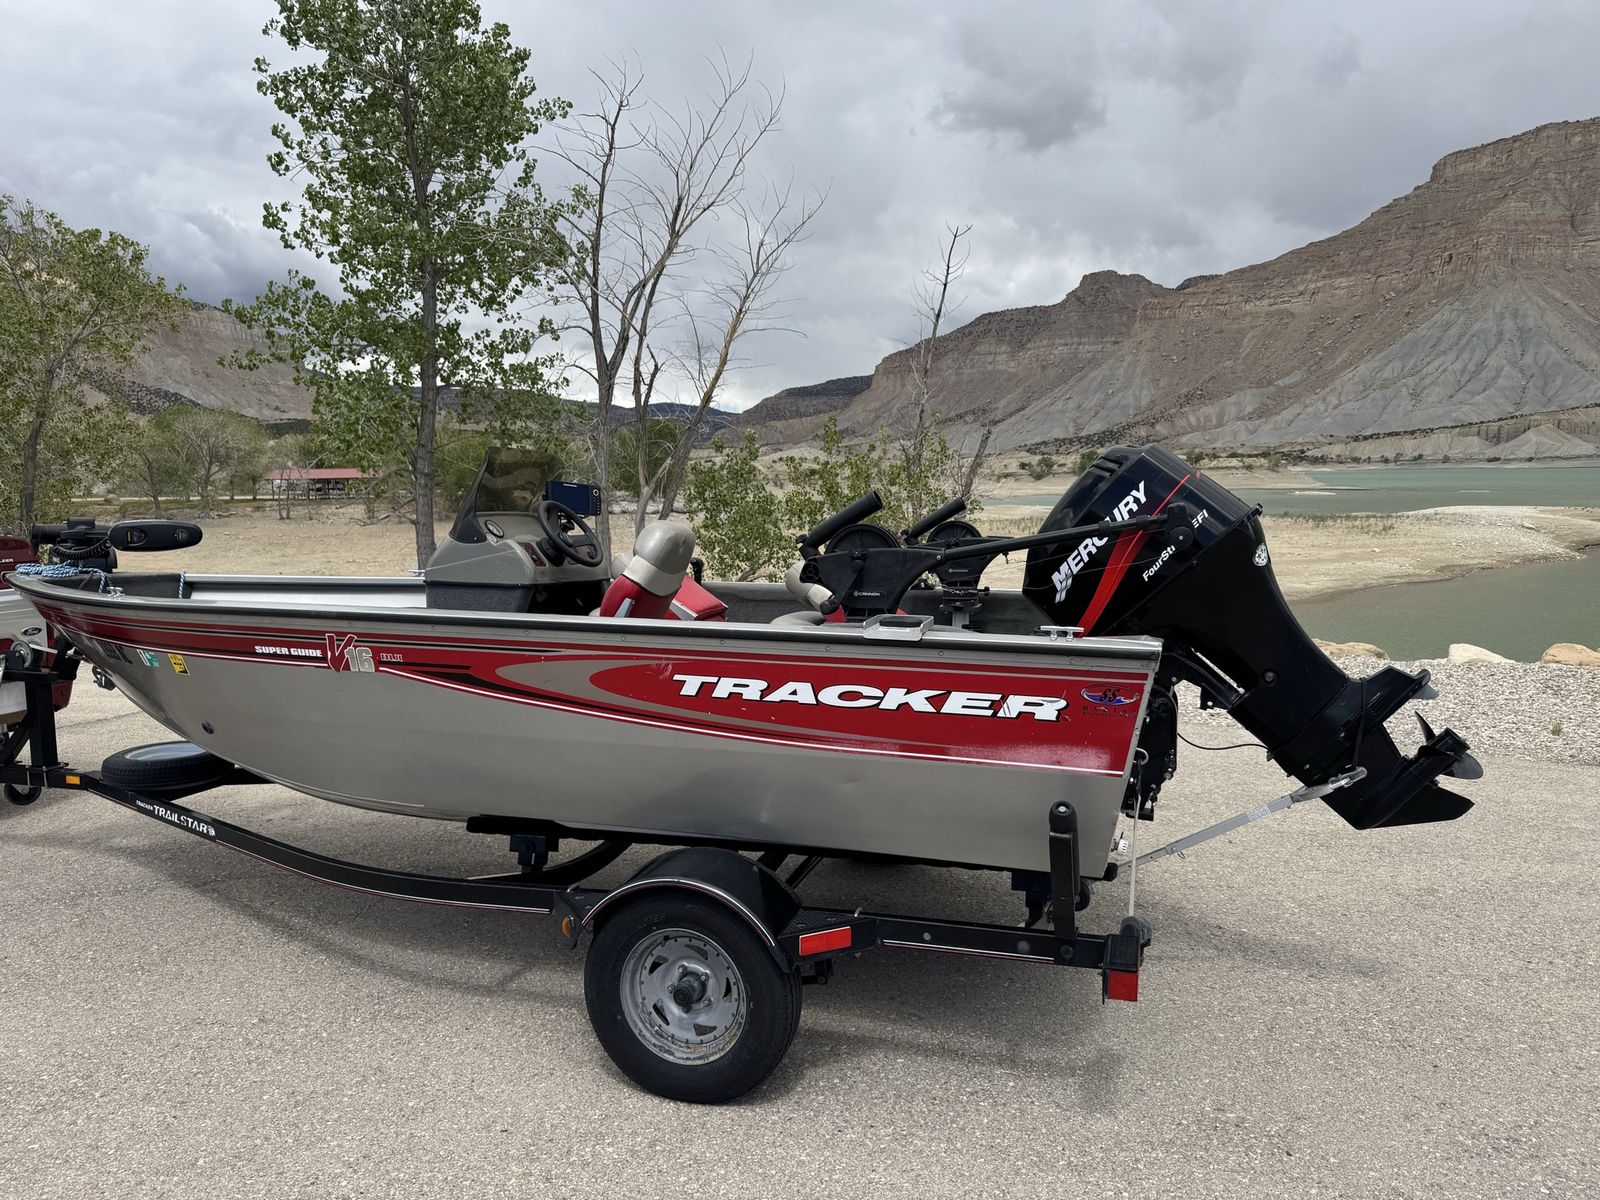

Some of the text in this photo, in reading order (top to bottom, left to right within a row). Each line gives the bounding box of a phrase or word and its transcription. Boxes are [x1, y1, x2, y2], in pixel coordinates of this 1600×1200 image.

[254, 645, 288, 655] SUPER
[290, 648, 323, 657] GUIDE
[325, 633, 375, 672] V16
[672, 674, 1069, 721] TRACKER
